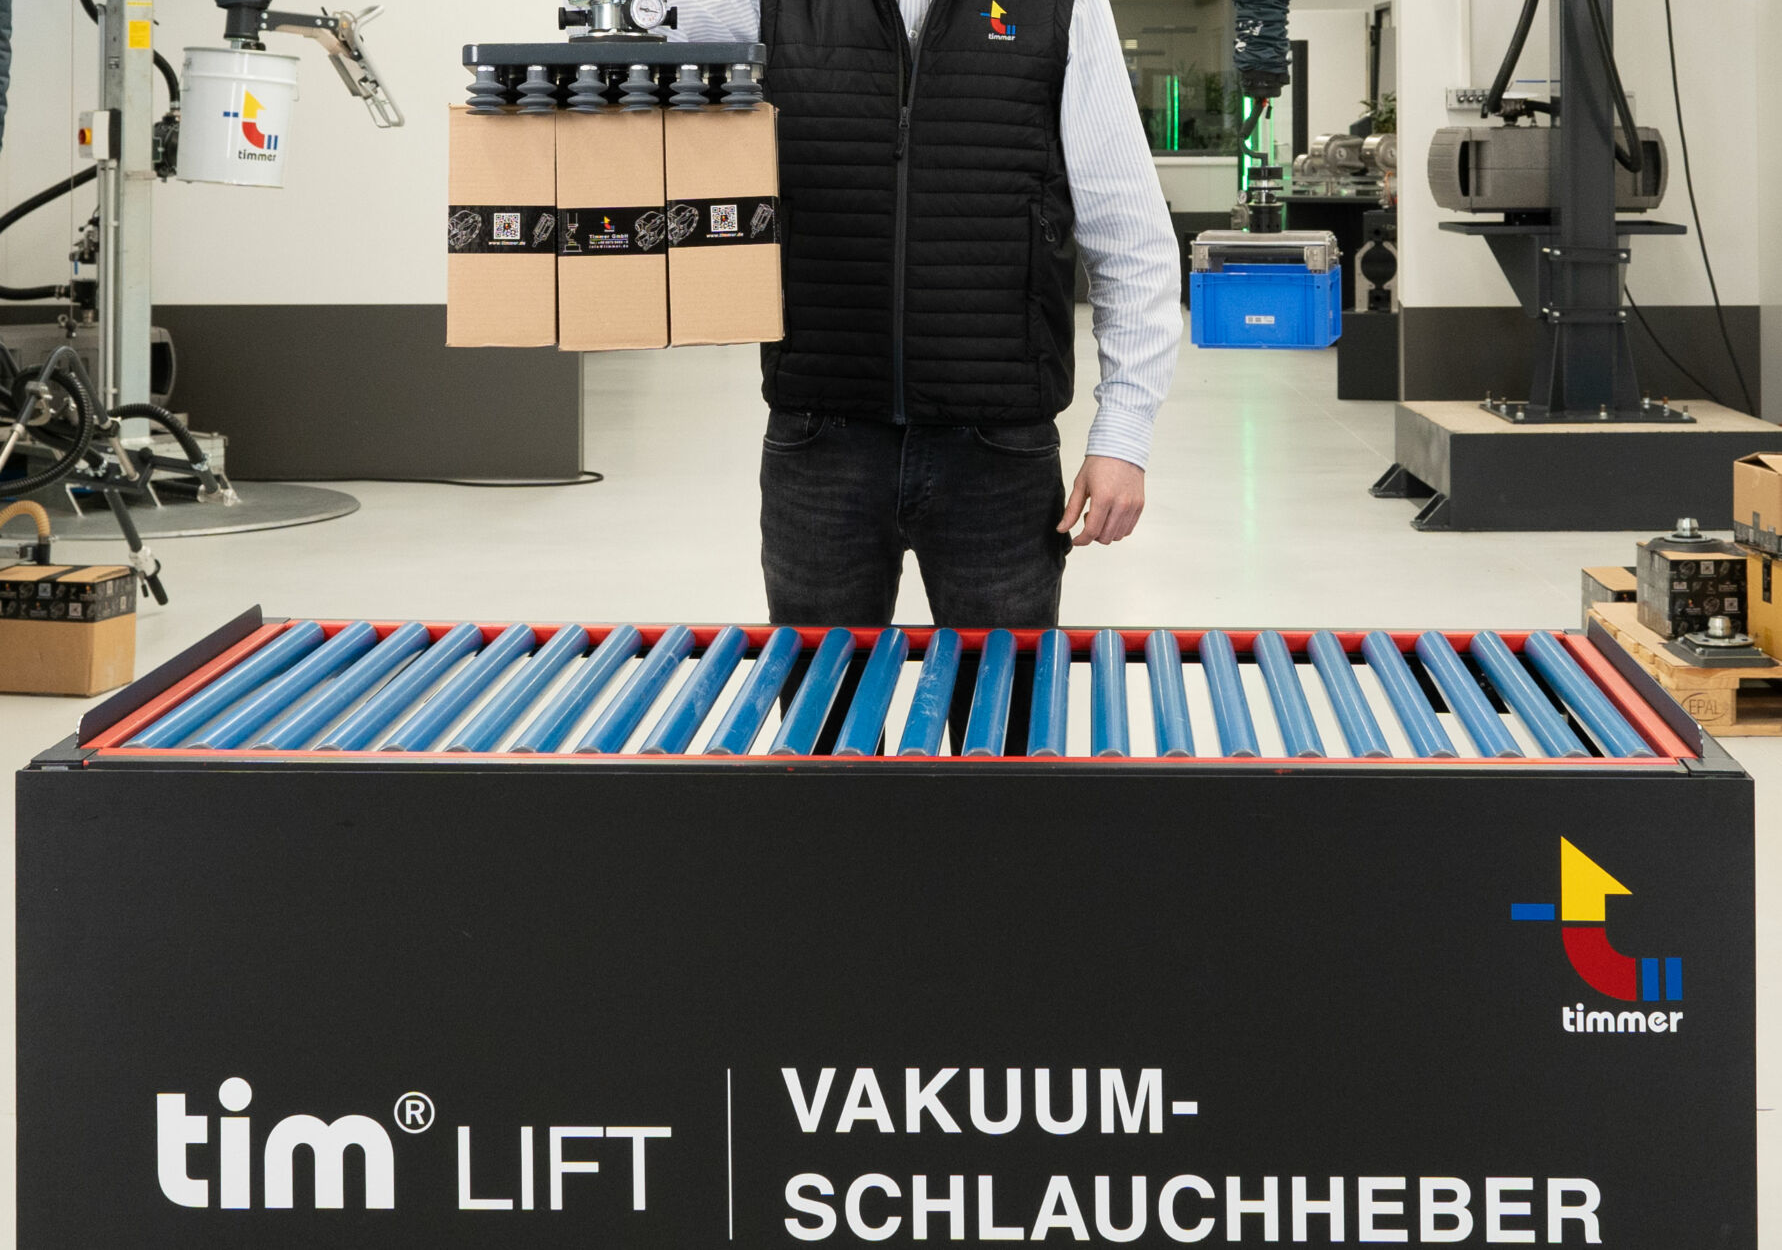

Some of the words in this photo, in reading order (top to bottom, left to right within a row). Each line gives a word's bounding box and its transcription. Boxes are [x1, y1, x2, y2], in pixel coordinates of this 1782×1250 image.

[988, 33, 1016, 41] timmer
[238, 149, 276, 161] timmer
[1689, 699, 1721, 715] EPAL
[1562, 1002, 1684, 1033] timmer
[780, 1067, 1198, 1135] VAKUUM-
[457, 1125, 672, 1211] LIFT
[784, 1172, 1603, 1244] SCHLAUCHHEBER
